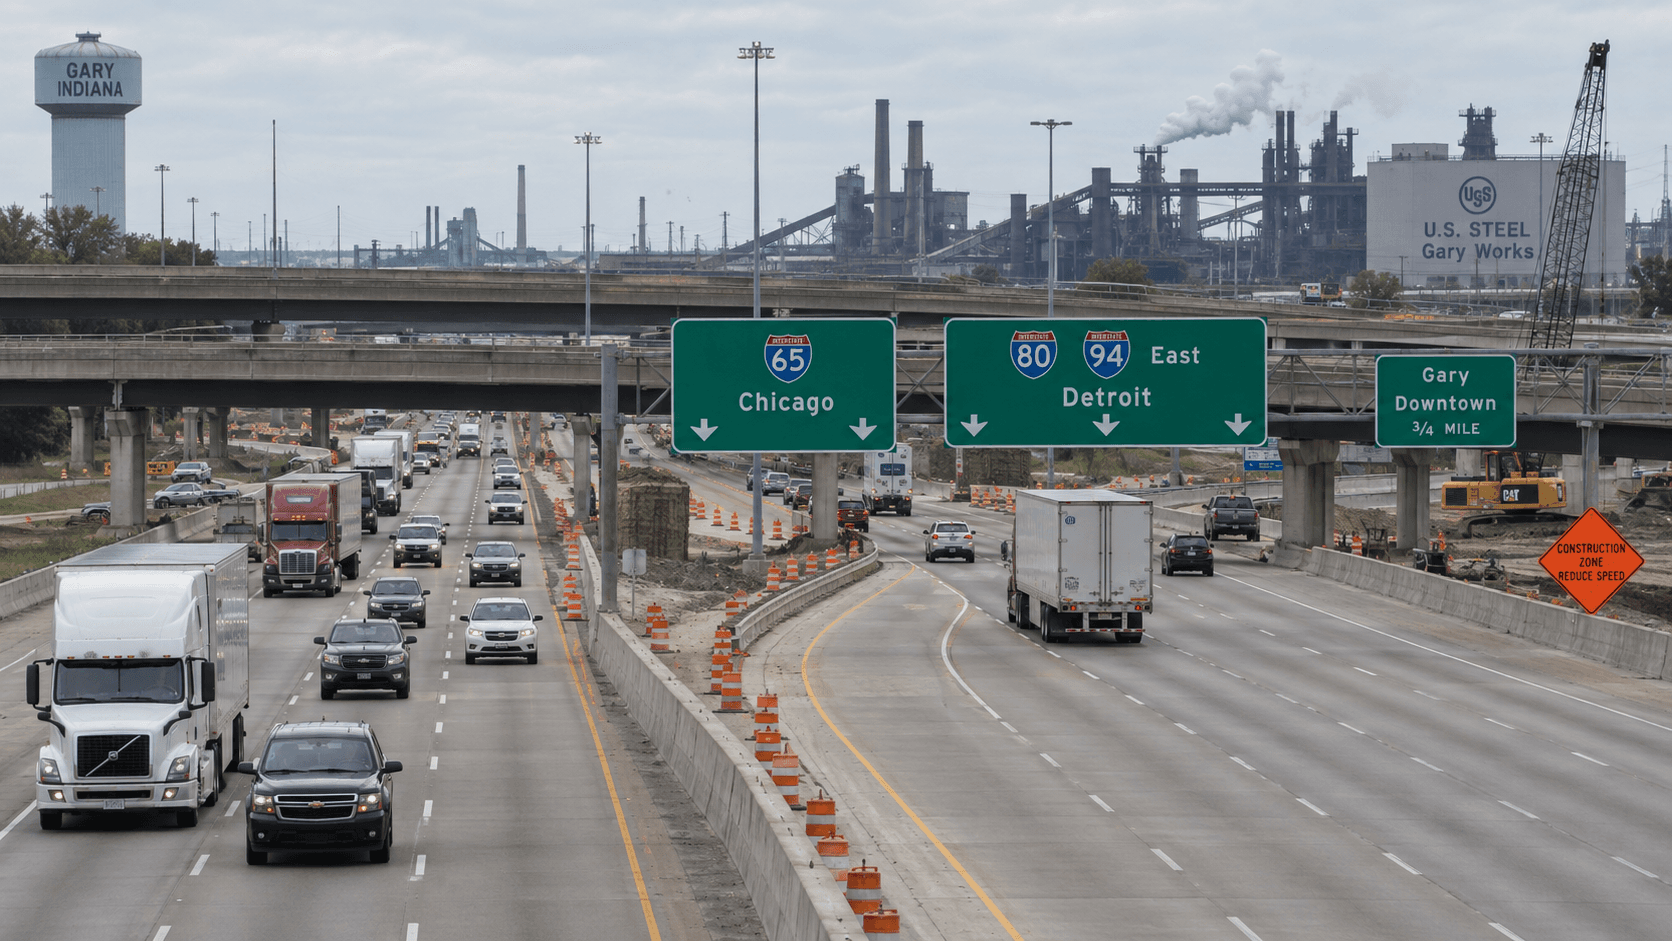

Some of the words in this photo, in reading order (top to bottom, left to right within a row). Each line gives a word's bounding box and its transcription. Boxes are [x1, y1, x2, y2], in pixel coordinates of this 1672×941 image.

[66, 62, 115, 78] GARY
[57, 80, 123, 96] INDIANA
[1424, 221, 1461, 238] U.S.
[1469, 221, 1531, 238] STEEL
[1422, 243, 1466, 263] Gary
[1474, 242, 1535, 259] Works
[772, 348, 805, 372] 65
[1017, 343, 1051, 368] 80
[1090, 343, 1124, 368] 94
[1152, 345, 1200, 365] East
[1422, 366, 1470, 387] Gary
[739, 391, 834, 417] Chicago
[1063, 386, 1152, 408] Detroit
[1395, 395, 1496, 411] Downtown
[1412, 420, 1434, 436] 3/4
[1445, 422, 1480, 436] MILE
[1502, 488, 1520, 502] CAT
[1557, 543, 1626, 554] CONSTRUCTION
[1579, 557, 1604, 568] ZONE
[1558, 571, 1593, 582] REDUCE
[1597, 571, 1625, 582] SPEED
